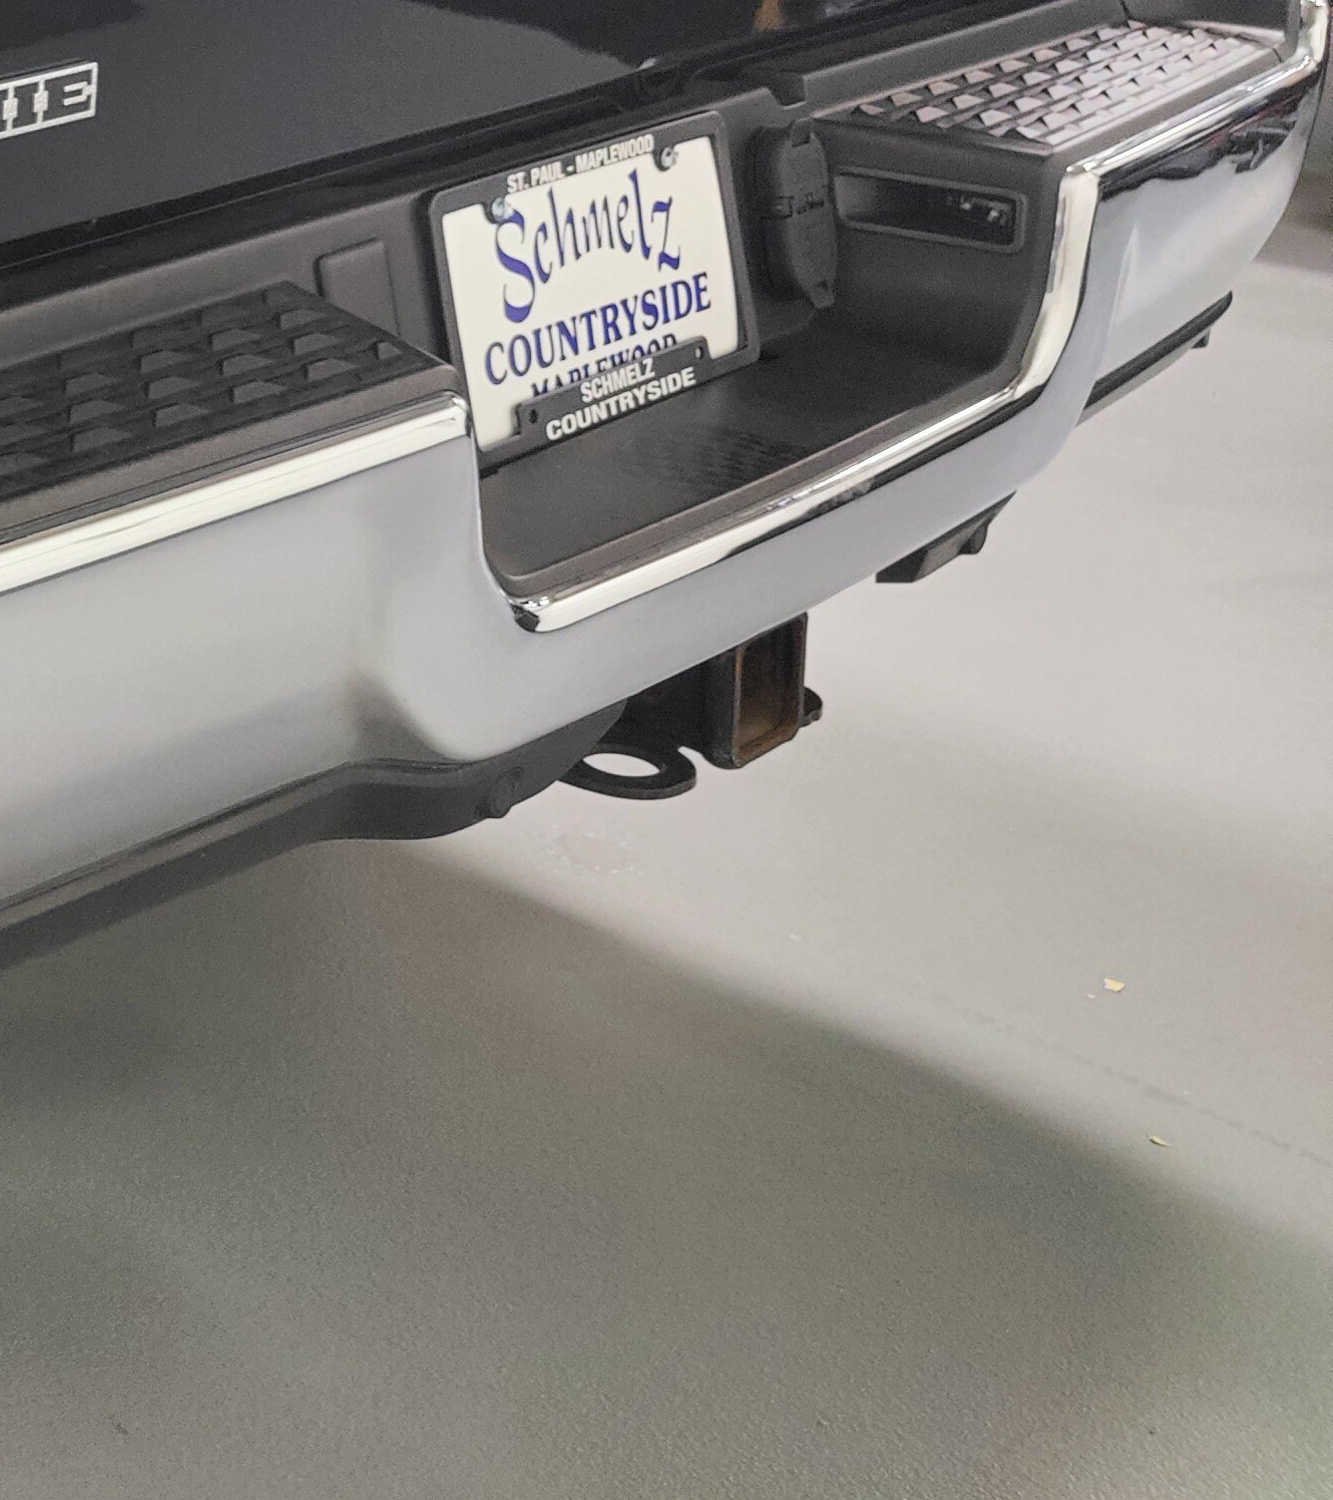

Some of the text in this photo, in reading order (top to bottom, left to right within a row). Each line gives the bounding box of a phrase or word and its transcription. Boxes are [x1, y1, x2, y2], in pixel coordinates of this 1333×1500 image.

[506, 171, 530, 194] ST.
[530, 161, 565, 187] PAUL
[575, 133, 655, 174] MAPLEWOOD
[494, 168, 680, 322] Schmelz
[484, 271, 712, 386] COUNTRYSIDE
[545, 366, 697, 441] COUNTRYSIDE
[579, 357, 656, 404] SCHMELZ
